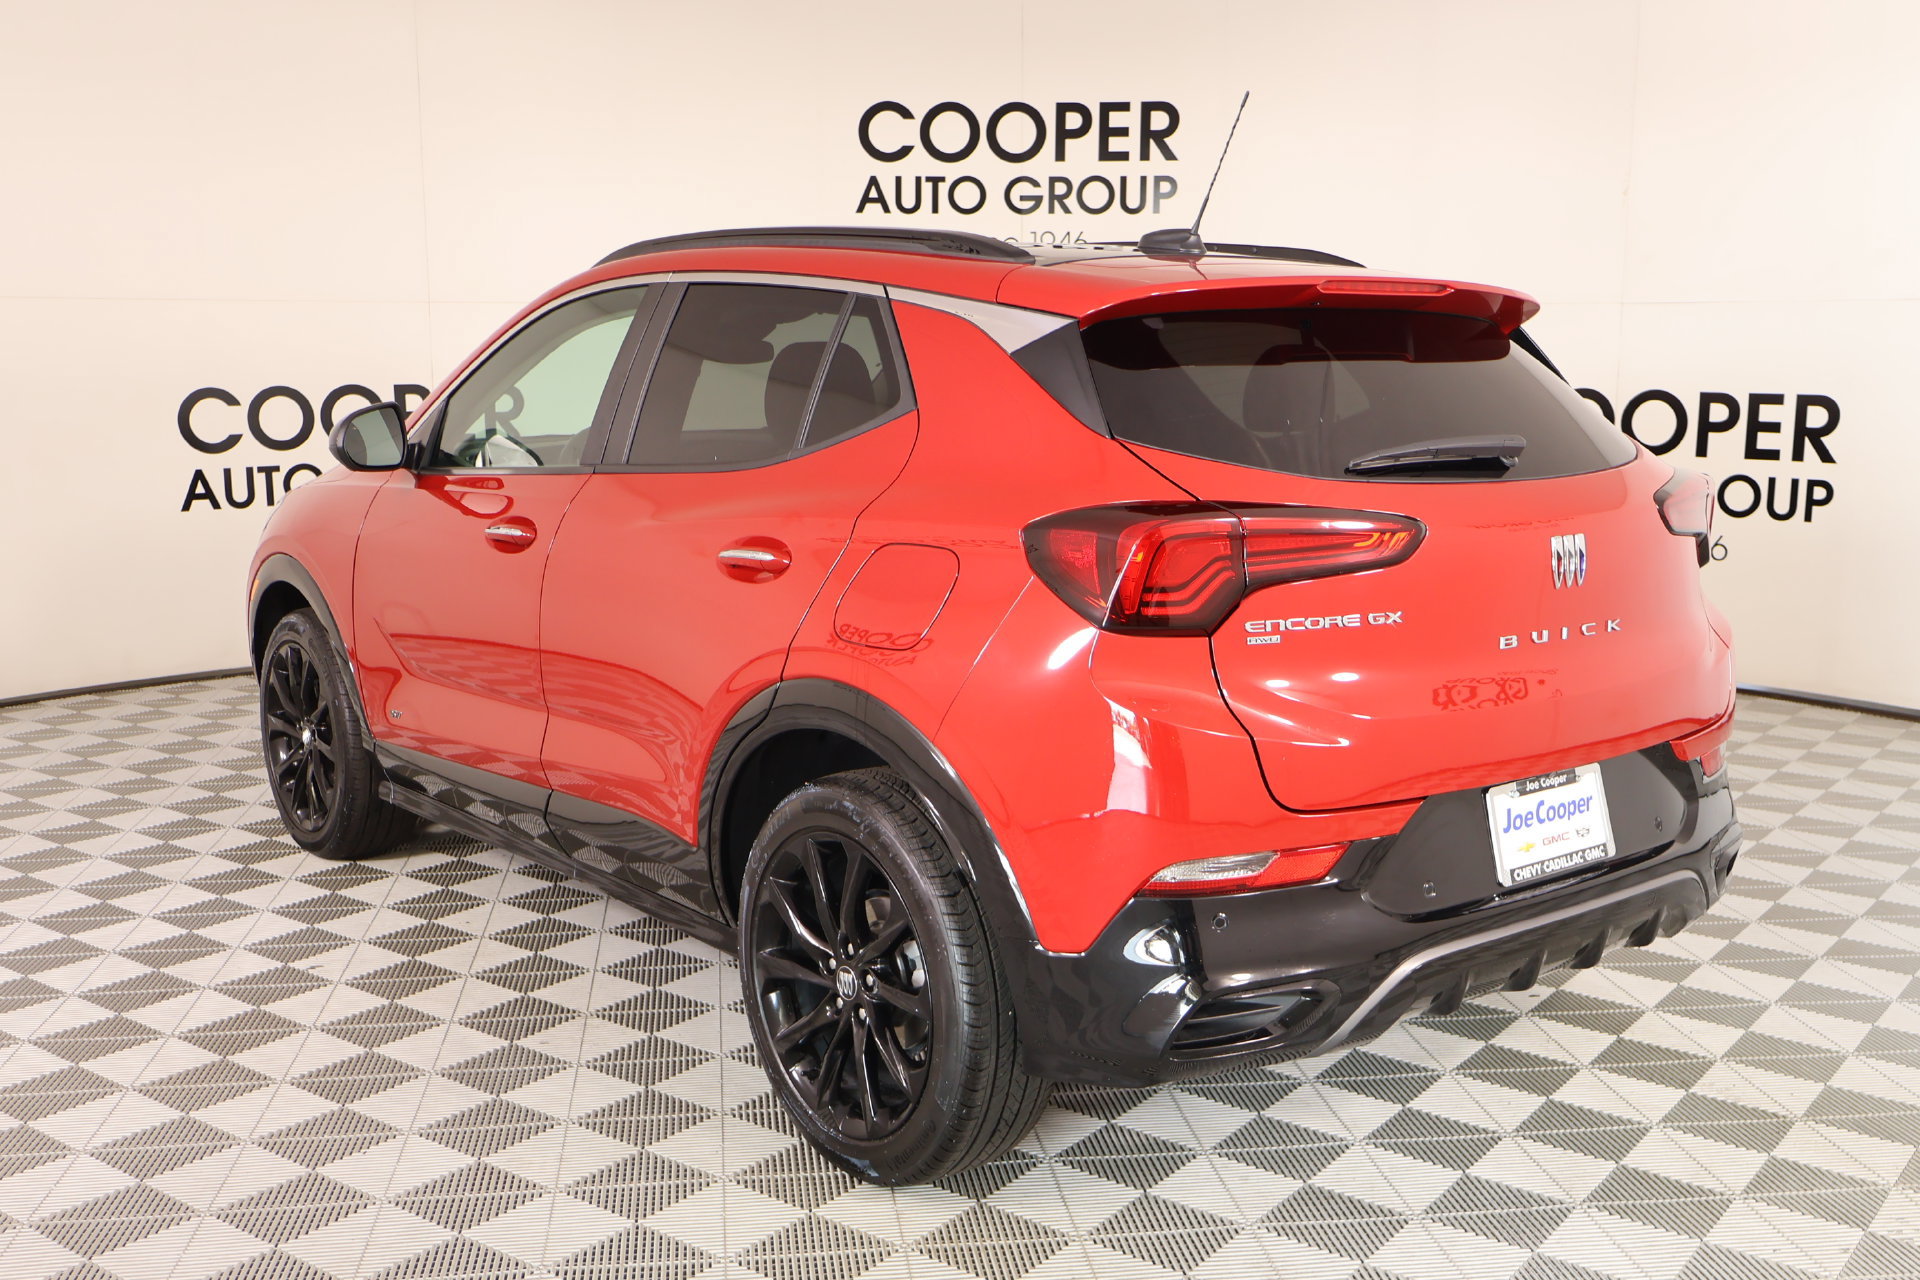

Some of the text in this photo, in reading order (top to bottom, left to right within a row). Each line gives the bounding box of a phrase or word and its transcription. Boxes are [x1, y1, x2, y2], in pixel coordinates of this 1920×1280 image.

[858, 101, 1180, 163] COOPER
[856, 175, 1178, 215] AUTO GROUP
[1245, 611, 1403, 633] ENCORE GX
[1499, 618, 1622, 650] BUICK
[1525, 774, 1567, 792] Joe Cooper
[1542, 831, 1570, 846] GMC
[1514, 845, 1606, 881] CHEVY CADILLAC GMC
